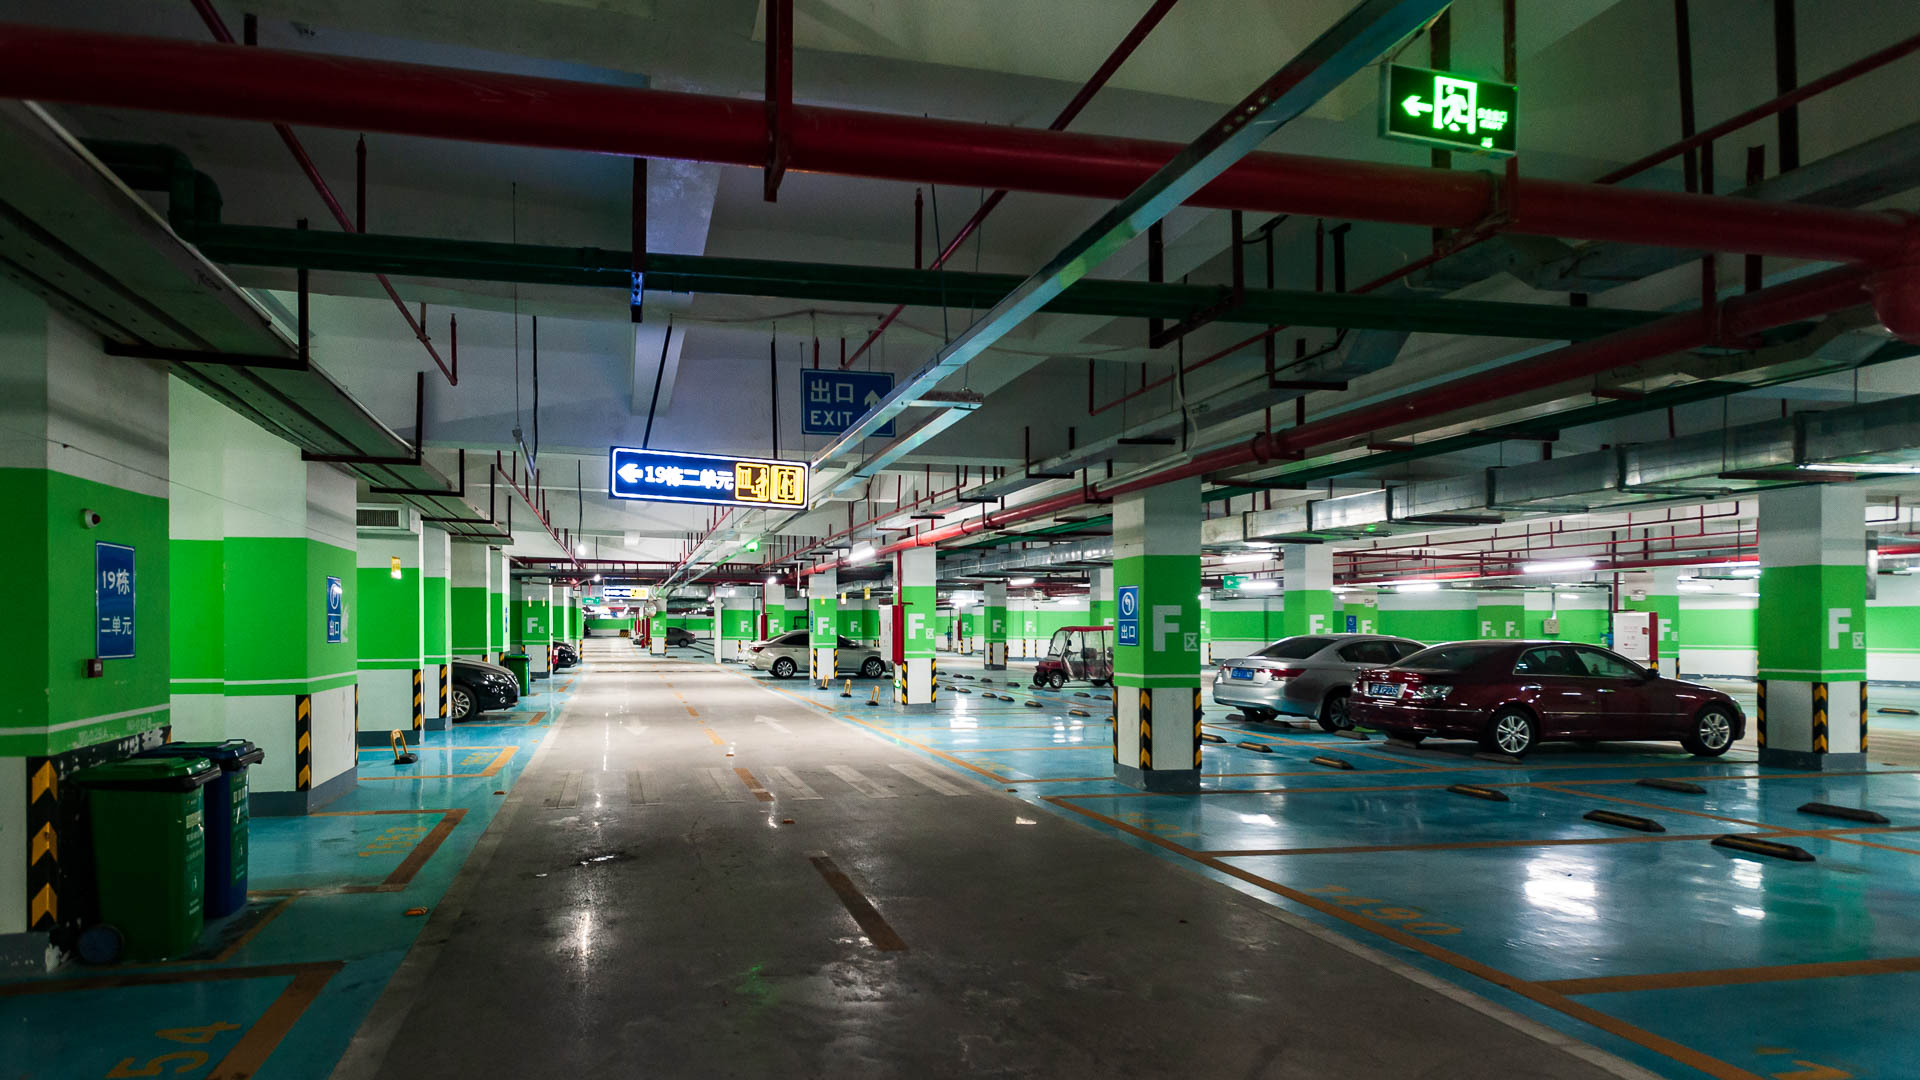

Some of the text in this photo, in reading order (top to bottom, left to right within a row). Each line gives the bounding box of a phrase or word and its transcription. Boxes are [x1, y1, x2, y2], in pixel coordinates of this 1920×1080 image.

[810, 379, 854, 403] 出口
[810, 410, 854, 427] EXIT
[102, 568, 130, 595] 19栋
[101, 616, 132, 635] 二单元
[1120, 624, 1136, 639] 出口
[1152, 604, 1199, 652] F区
